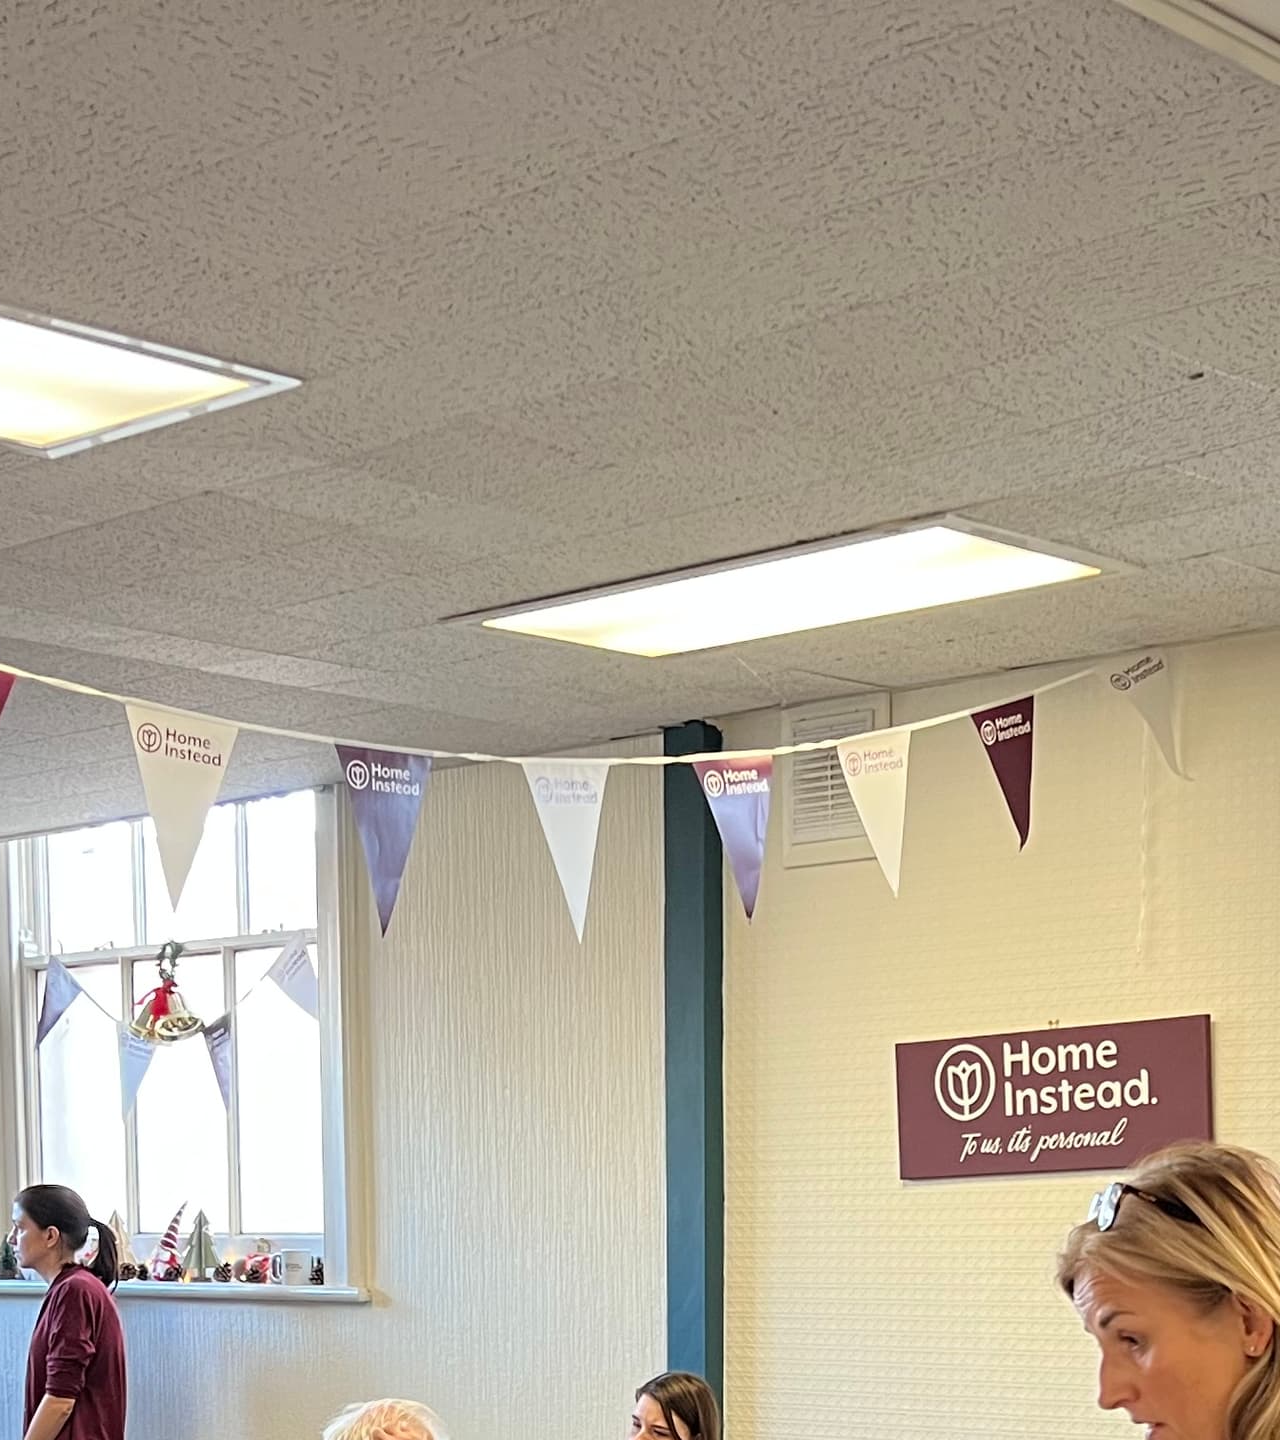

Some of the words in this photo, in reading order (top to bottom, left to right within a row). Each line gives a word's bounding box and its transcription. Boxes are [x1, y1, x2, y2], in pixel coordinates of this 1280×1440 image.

[995, 714, 1023, 729] Home
[166, 728, 211, 749] Home
[165, 743, 222, 766] Instead
[371, 763, 410, 780] Home
[723, 769, 758, 783] Home
[372, 778, 420, 796] Instead
[1003, 1040, 1118, 1077] Home
[1004, 1069, 1158, 1116] Instead.
[960, 1133, 982, 1162] To
[981, 1137, 1003, 1155] us,
[1007, 1125, 1032, 1152] it's
[1030, 1118, 1127, 1162] personal
